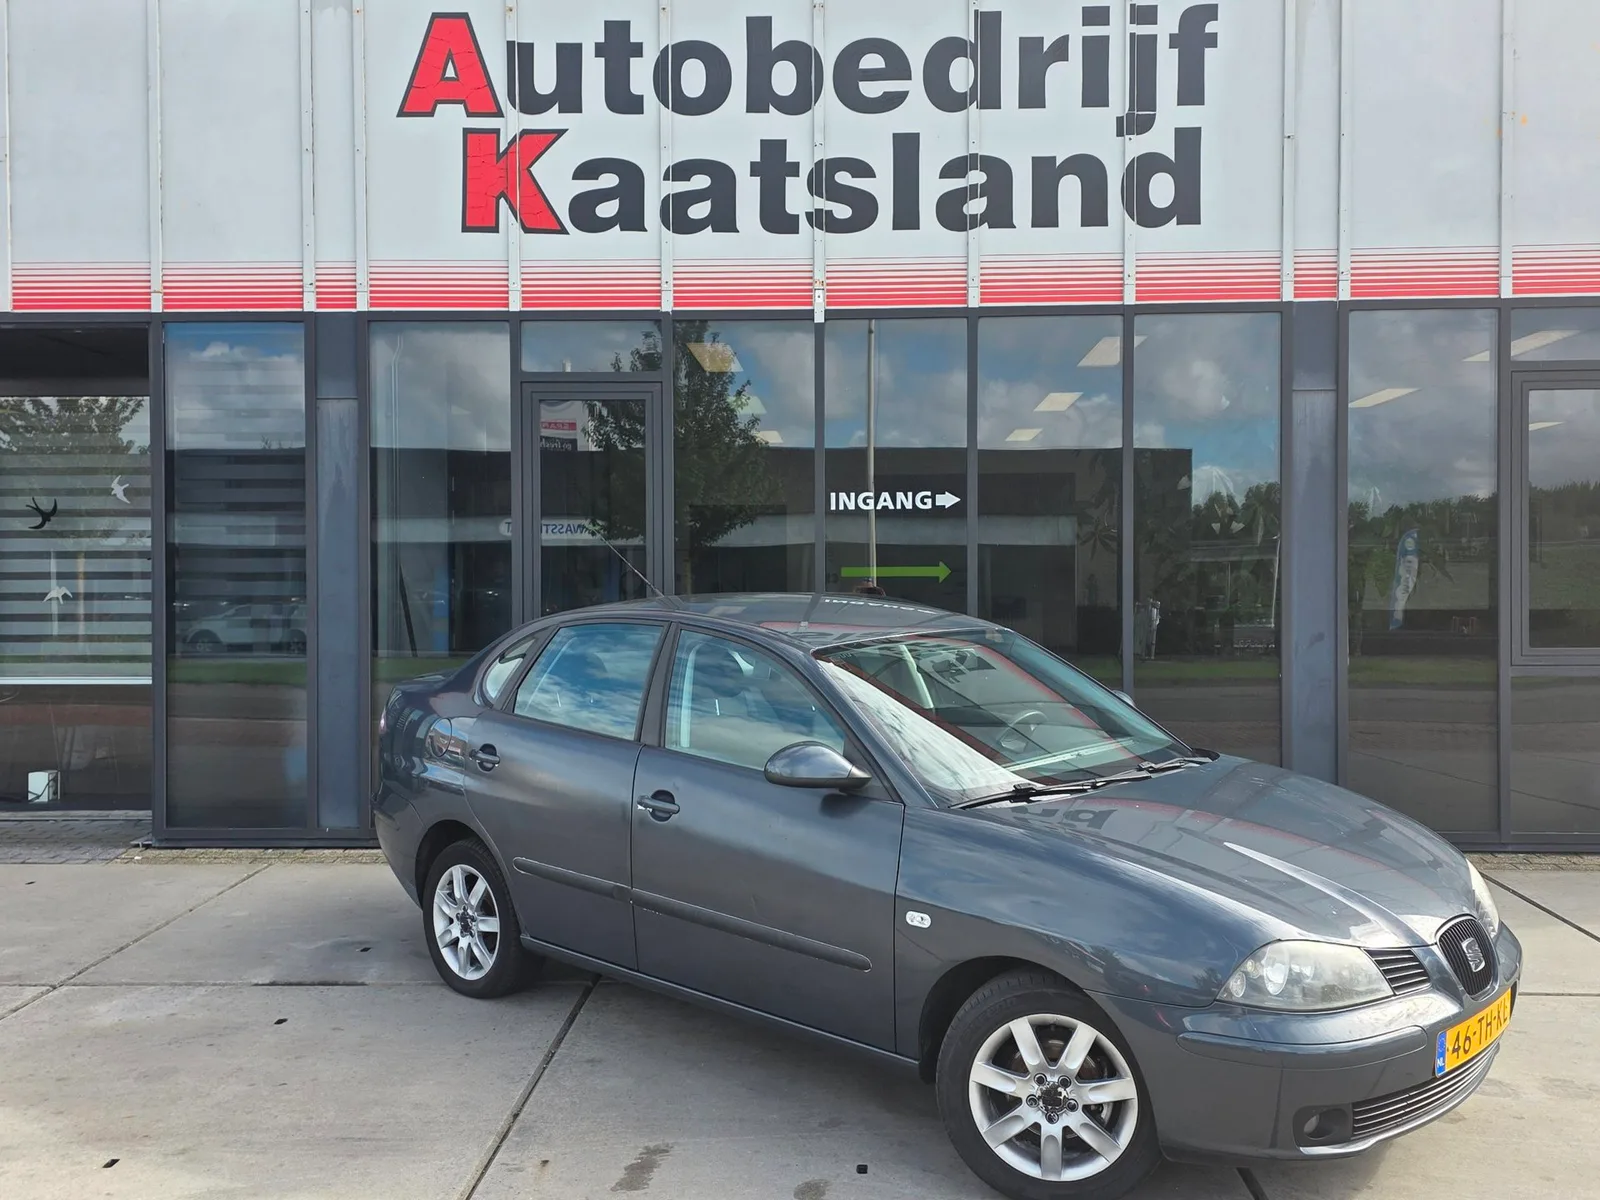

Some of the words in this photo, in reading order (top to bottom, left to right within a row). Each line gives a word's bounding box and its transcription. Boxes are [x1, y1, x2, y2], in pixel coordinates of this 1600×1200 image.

[396, 3, 1219, 137] Autobedrijf
[461, 127, 1203, 235] Kaatsland
[830, 491, 932, 510] INGANG
[1451, 996, 1508, 1060] 46-TH-KL
[1437, 1056, 1445, 1068] NL
